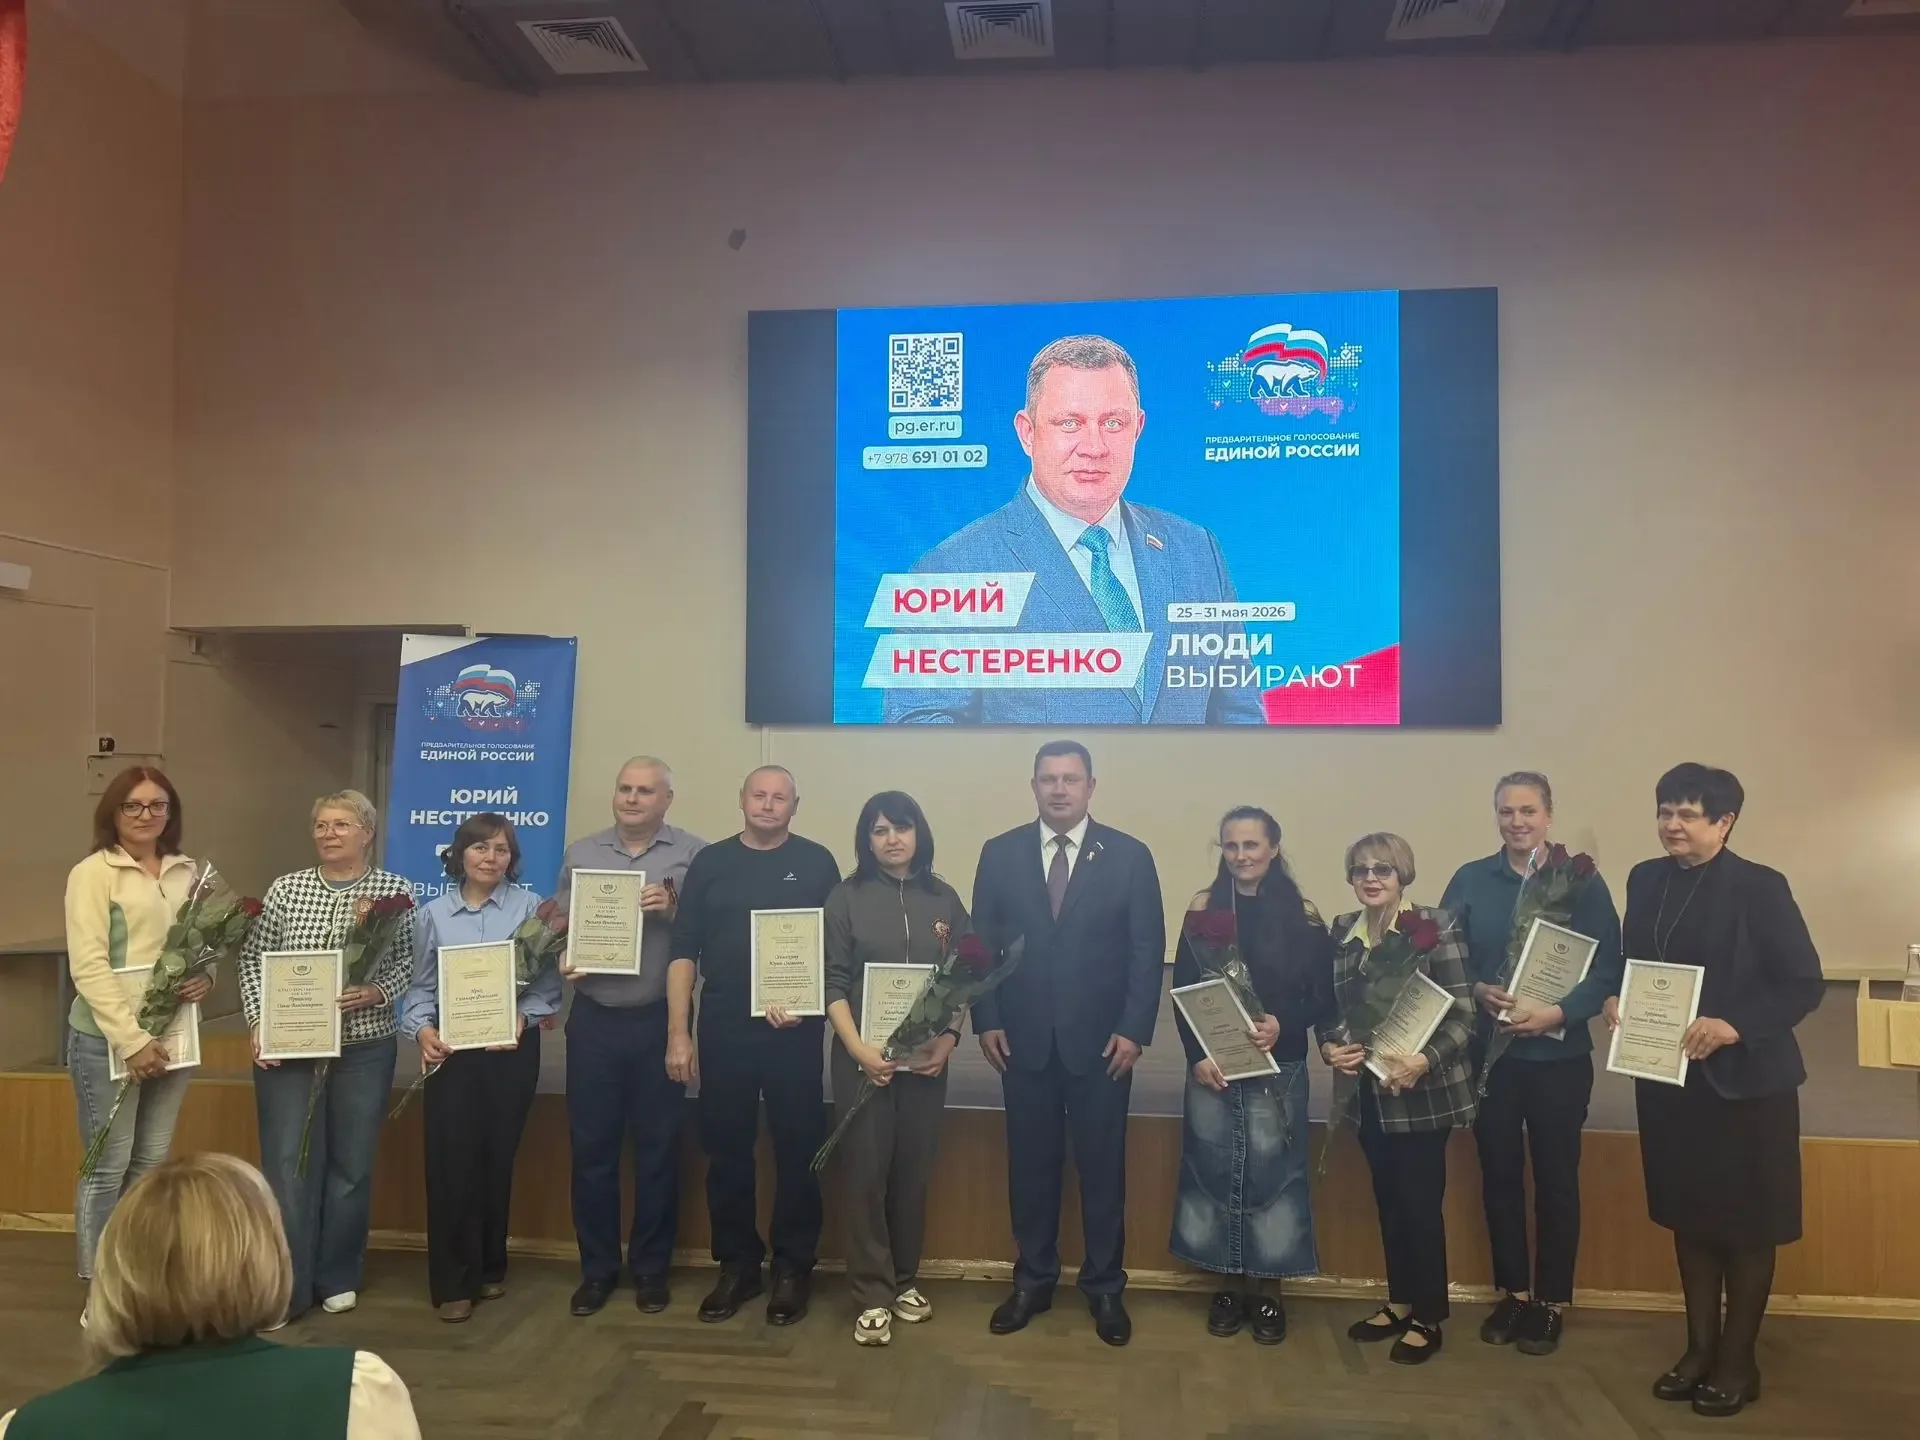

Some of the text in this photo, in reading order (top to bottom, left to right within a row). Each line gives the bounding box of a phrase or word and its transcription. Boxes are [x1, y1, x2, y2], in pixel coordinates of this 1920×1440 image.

[895, 420, 956, 435] pg.er.ru
[1205, 432, 1360, 444] ПРЕДВАРИТЕЛЬНОЕ ГОЛОСОВАНИЕ
[867, 449, 983, 465] +7 978 691 01 02
[1204, 443, 1360, 462] ЕДИНОЙ РОССИИ
[893, 581, 1004, 613] ЮРИЙ
[1221, 609, 1248, 618] мая
[1252, 606, 1286, 618] 2026
[1167, 633, 1273, 659] ЛЮДИ
[893, 648, 1122, 674] НЕСТЕРЕНКО
[1167, 665, 1362, 688] ВЫБИРАЮТ
[420, 749, 535, 761] ЕДИНОЙ РОССИИ
[450, 786, 518, 804] ЮРИЙ
[410, 810, 549, 826] НЕСТНКО
